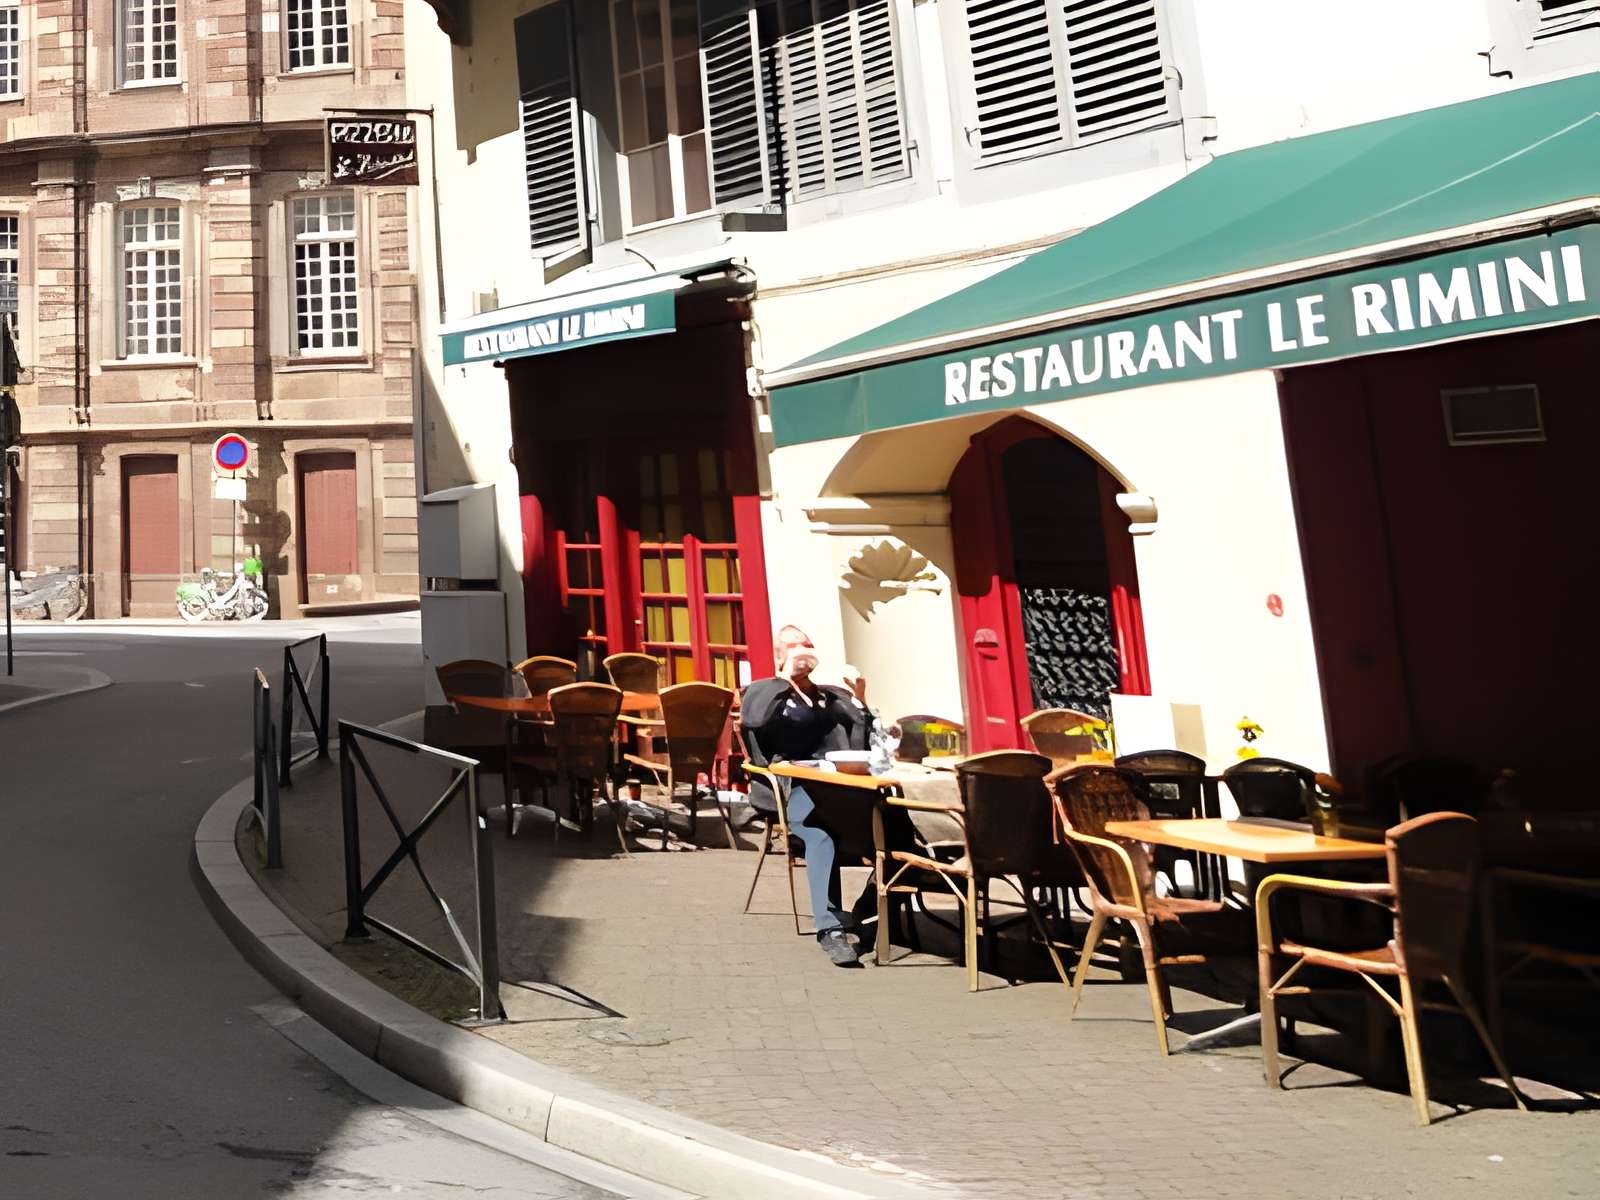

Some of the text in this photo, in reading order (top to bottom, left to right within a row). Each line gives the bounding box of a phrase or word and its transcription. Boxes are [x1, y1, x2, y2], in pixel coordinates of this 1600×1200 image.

[944, 244, 1586, 405] RESTAURANT LE RIMINI
